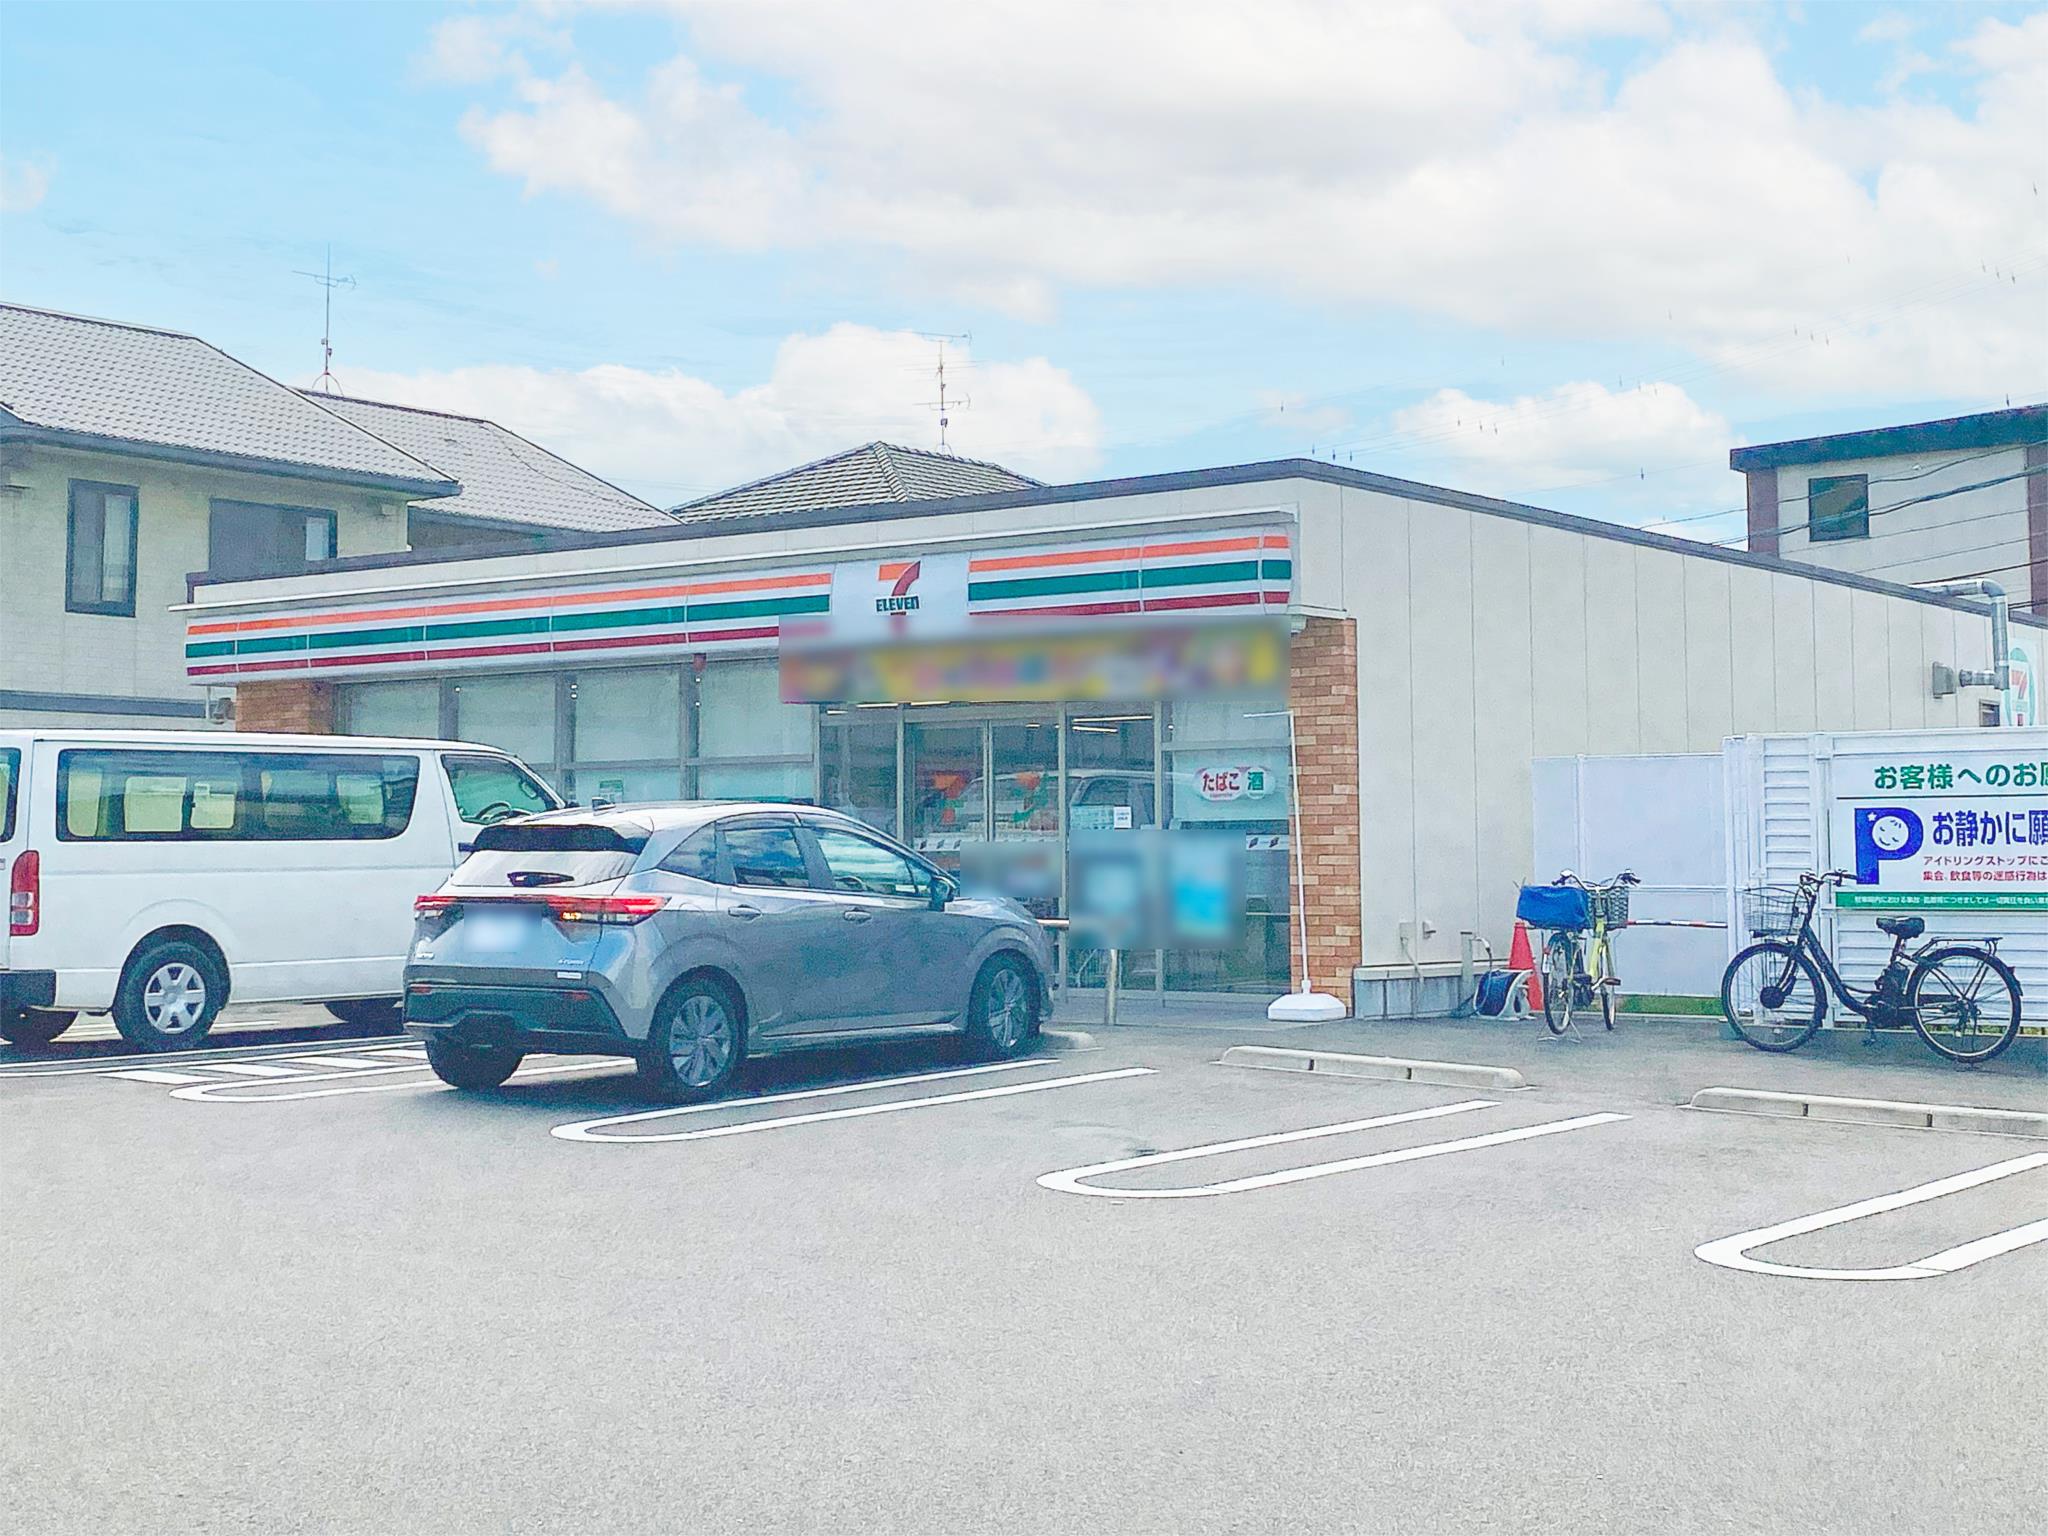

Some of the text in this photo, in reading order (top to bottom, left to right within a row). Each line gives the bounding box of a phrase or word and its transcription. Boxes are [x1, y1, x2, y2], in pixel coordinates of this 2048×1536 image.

[1202, 771, 1264, 792] たばこ 酒
[1932, 810, 2048, 847] お静かに願
